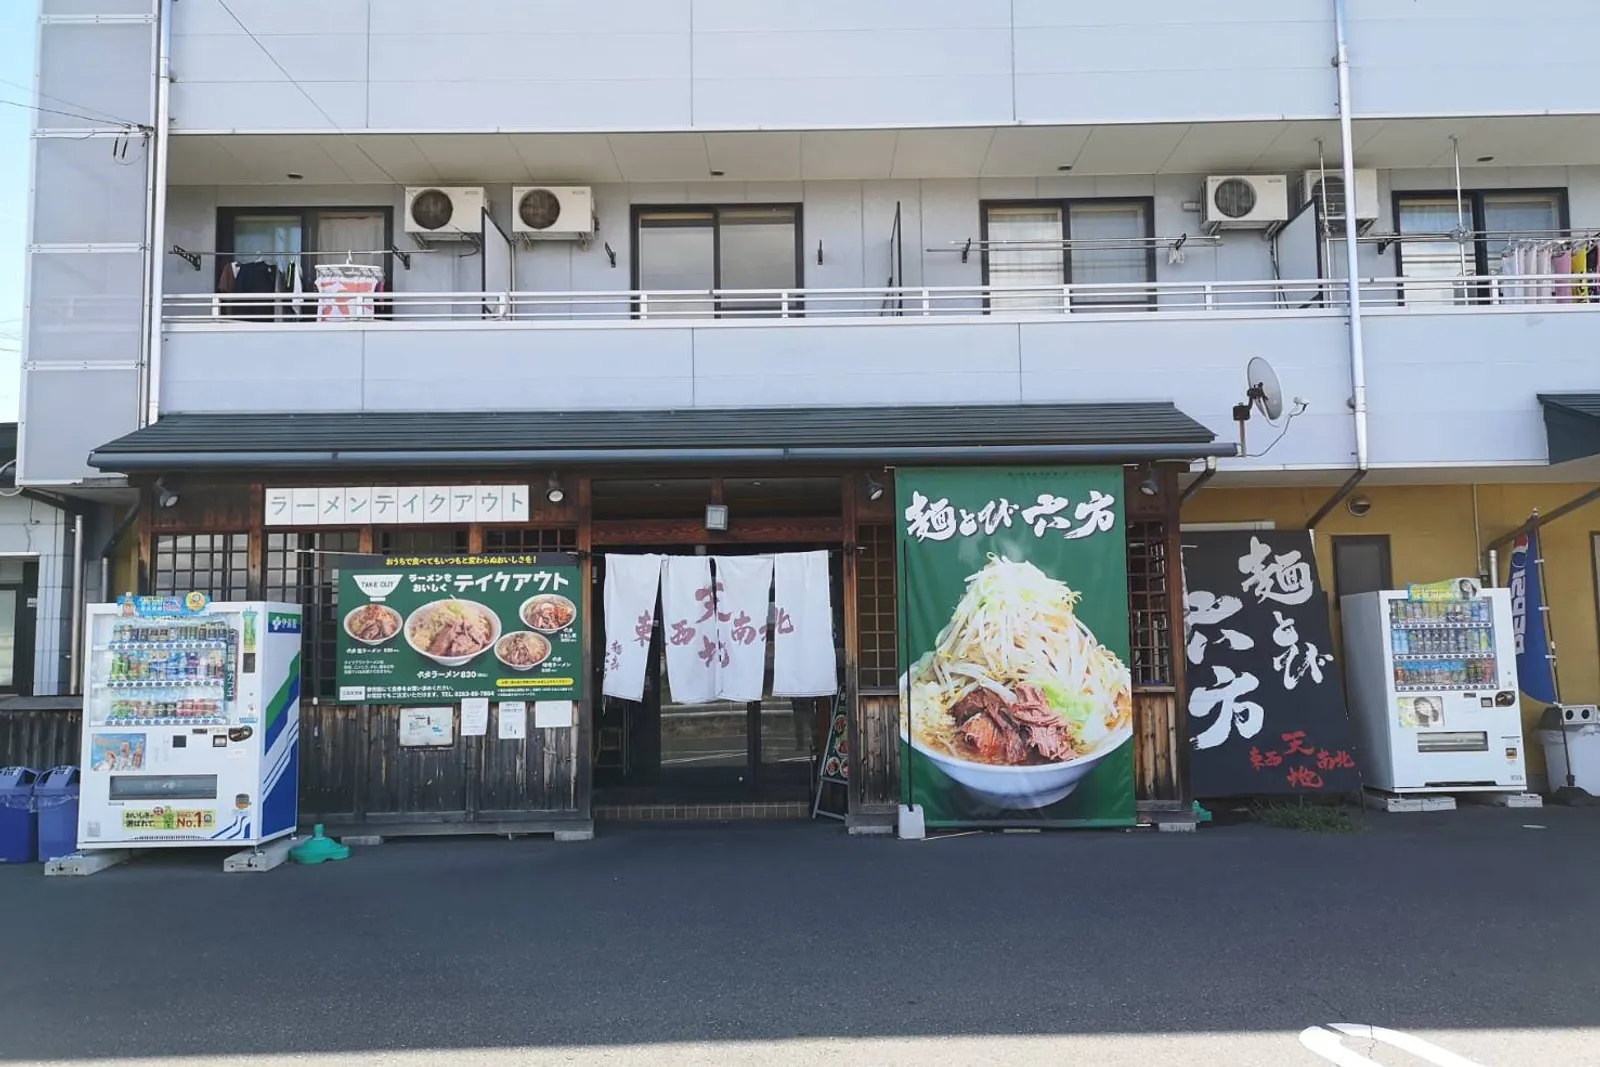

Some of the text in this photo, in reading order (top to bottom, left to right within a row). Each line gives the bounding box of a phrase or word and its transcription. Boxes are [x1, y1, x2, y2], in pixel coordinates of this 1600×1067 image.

[270, 491, 525, 516] ラーメンテイクアウト
[904, 490, 1116, 544] 麺とび六方
[361, 581, 379, 589] TAKE
[408, 573, 452, 583] ラーメンを
[412, 583, 448, 592] おいしく
[453, 571, 569, 593] テイクアウト
[1186, 589, 1266, 750] 六方
[1282, 731, 1315, 755] 天
[176, 811, 202, 827] No.1
